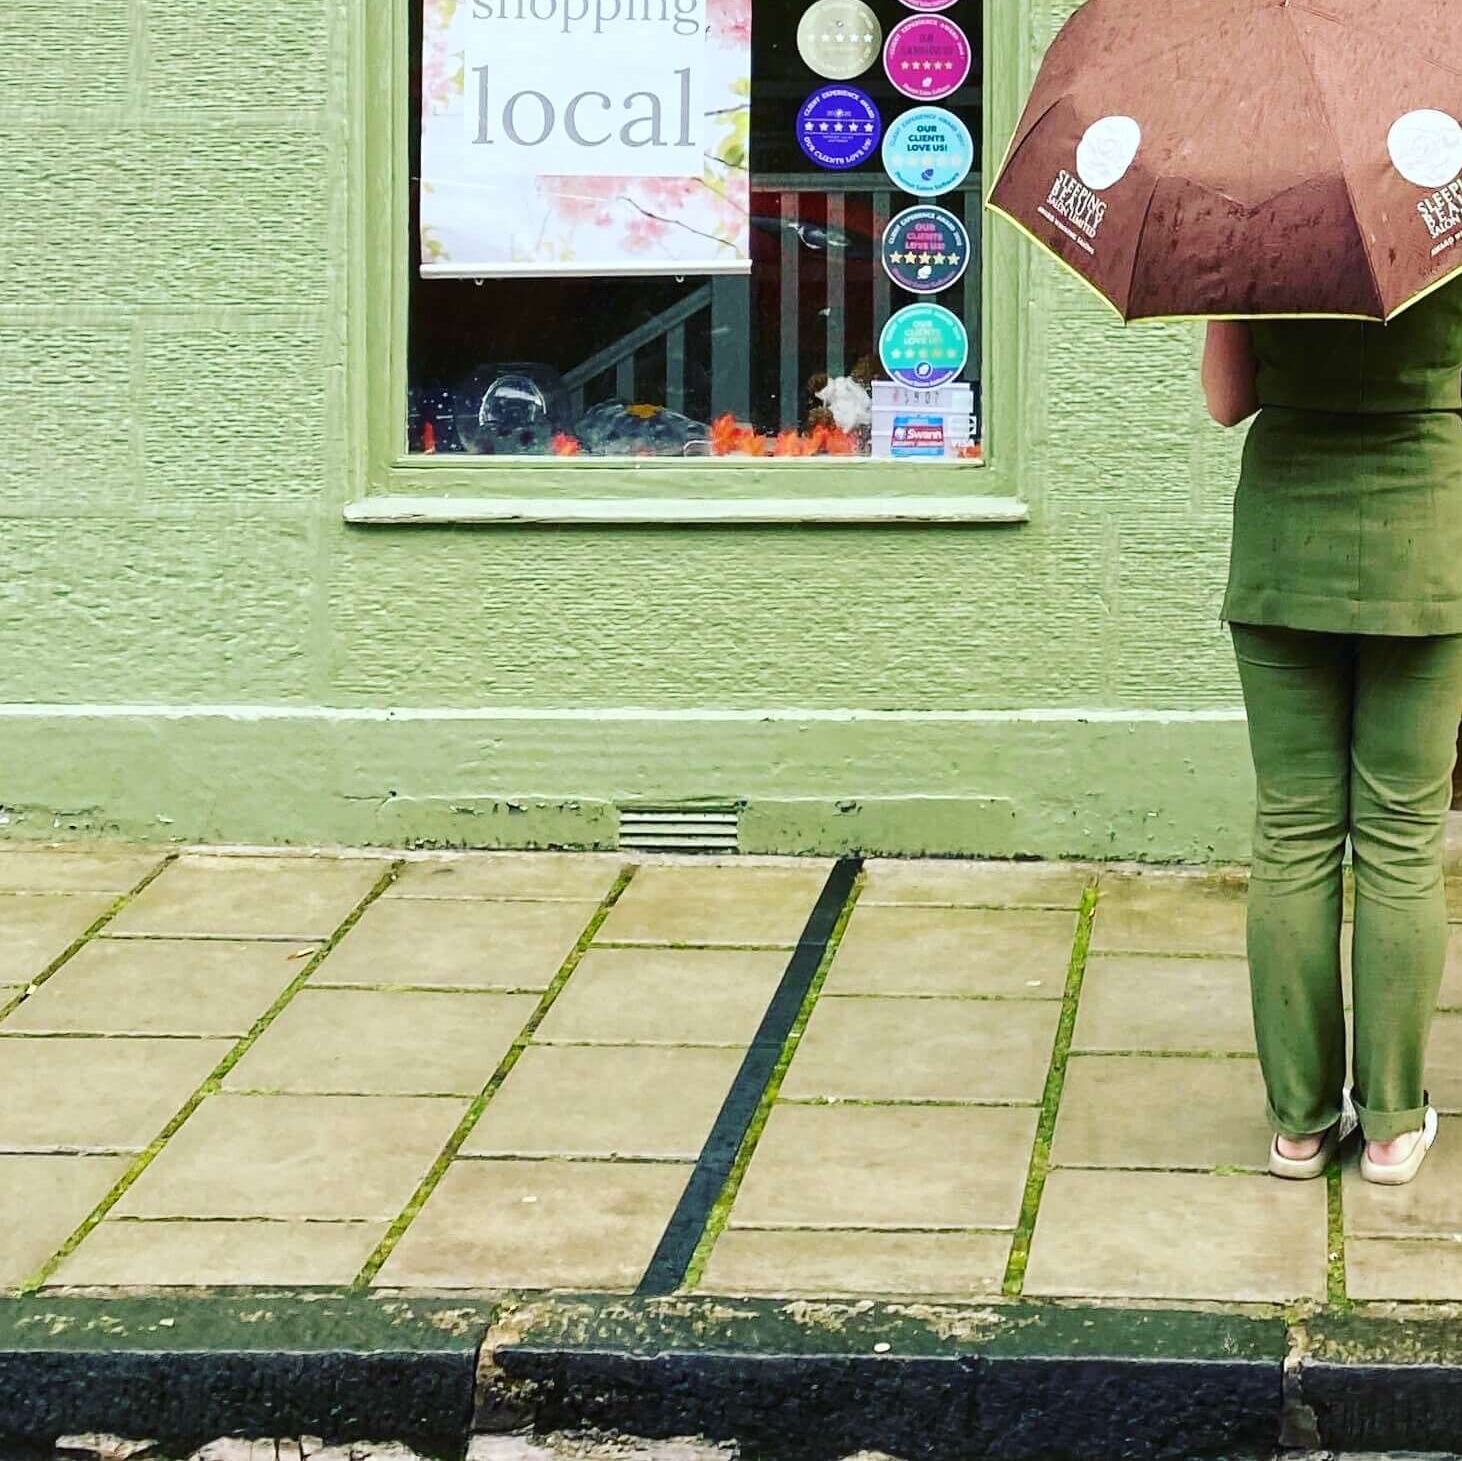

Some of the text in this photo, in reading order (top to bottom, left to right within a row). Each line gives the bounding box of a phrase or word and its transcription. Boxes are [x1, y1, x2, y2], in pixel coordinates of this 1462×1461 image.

[471, 64, 696, 147] local
[907, 144, 930, 152] LOVE
[1050, 177, 1104, 229] BEAUTY
[1059, 169, 1106, 217] SLEEPING
[907, 428, 942, 440] Swann
